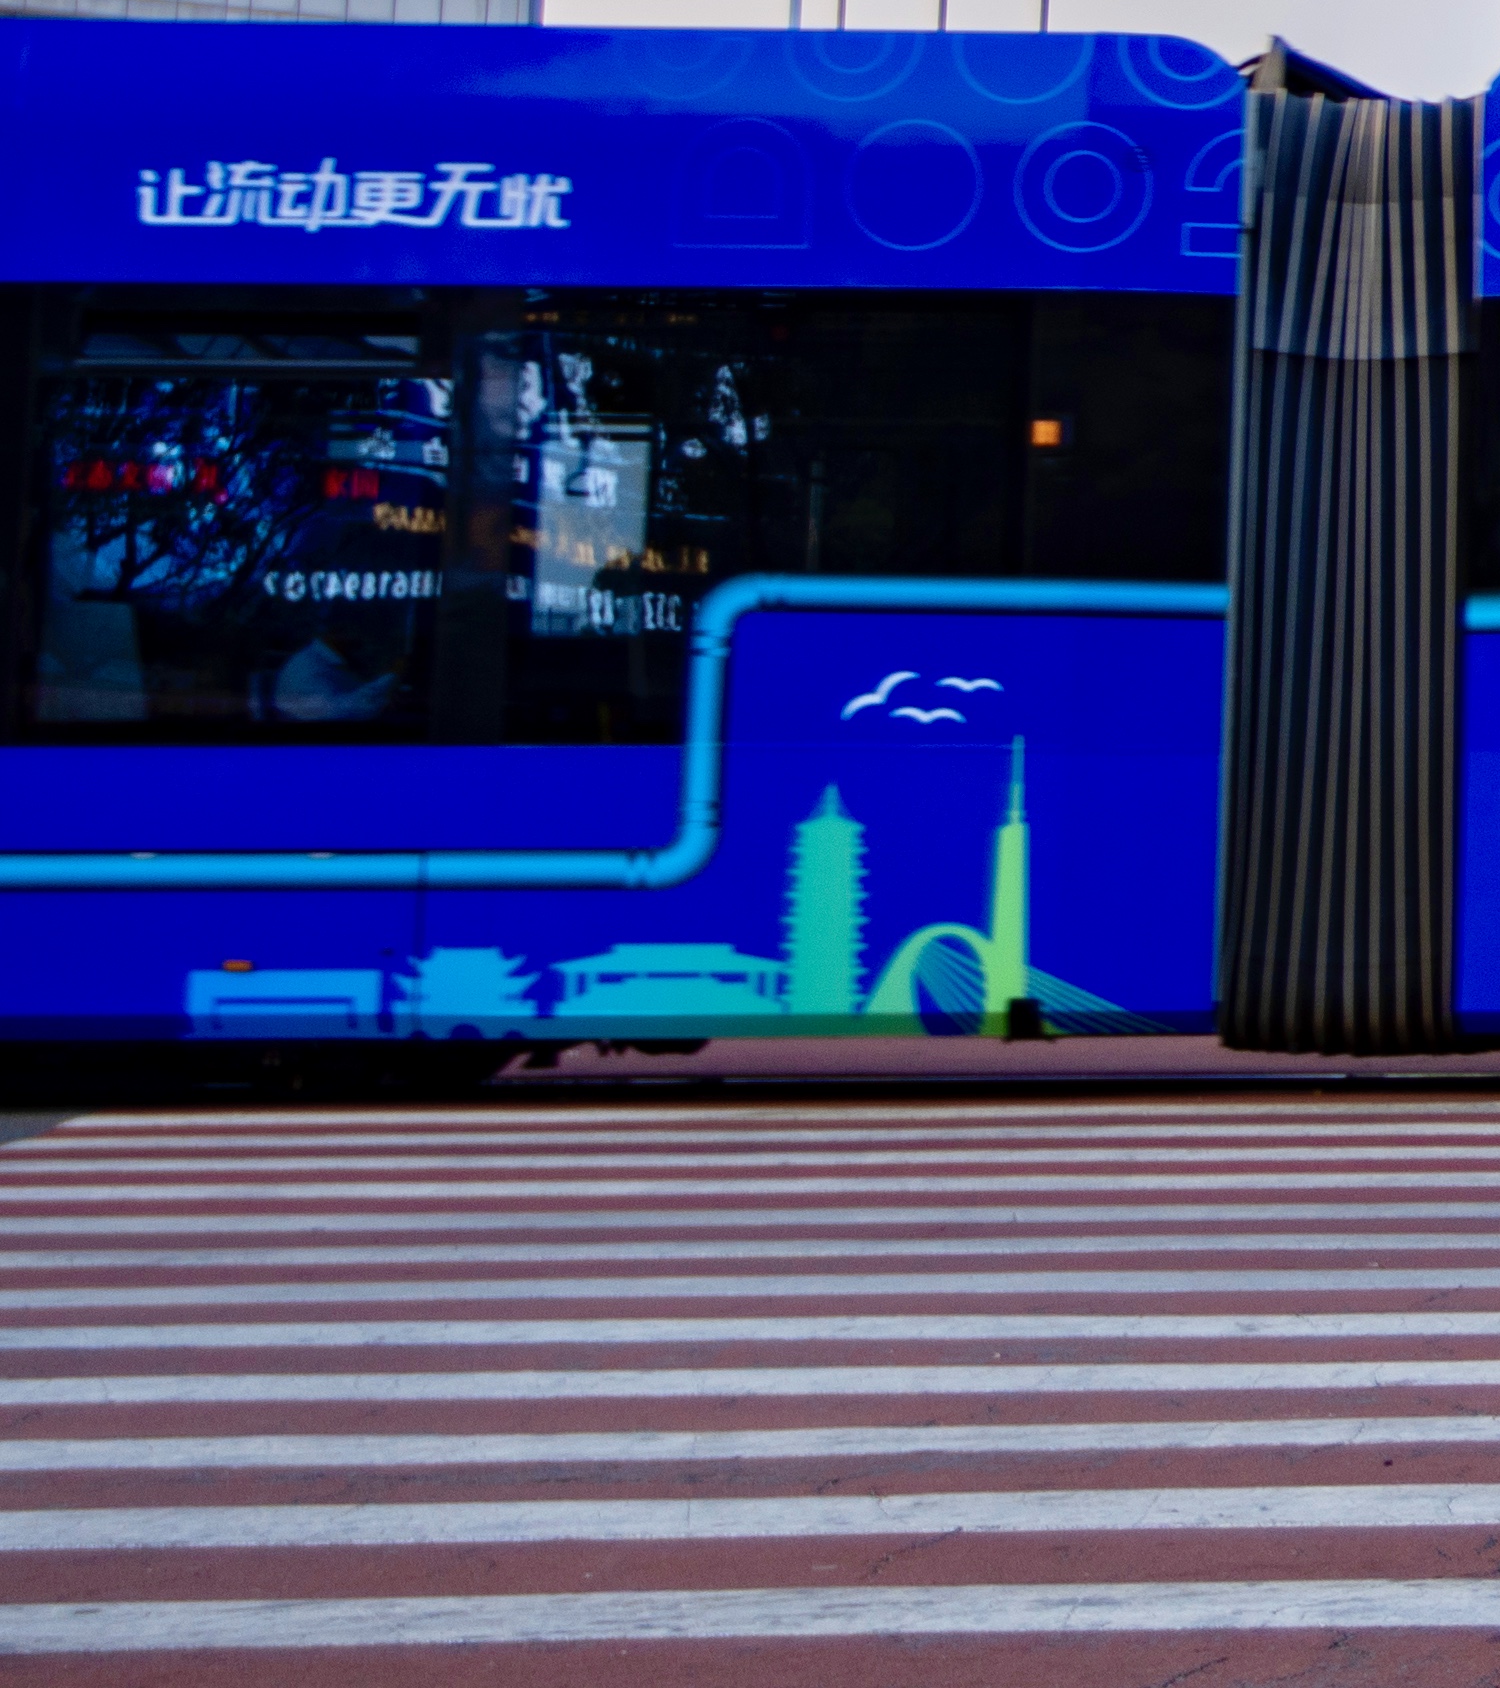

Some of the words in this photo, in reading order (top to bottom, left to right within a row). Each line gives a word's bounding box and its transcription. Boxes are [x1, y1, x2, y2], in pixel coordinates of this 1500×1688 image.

[136, 157, 574, 232] 让流动更无忧
